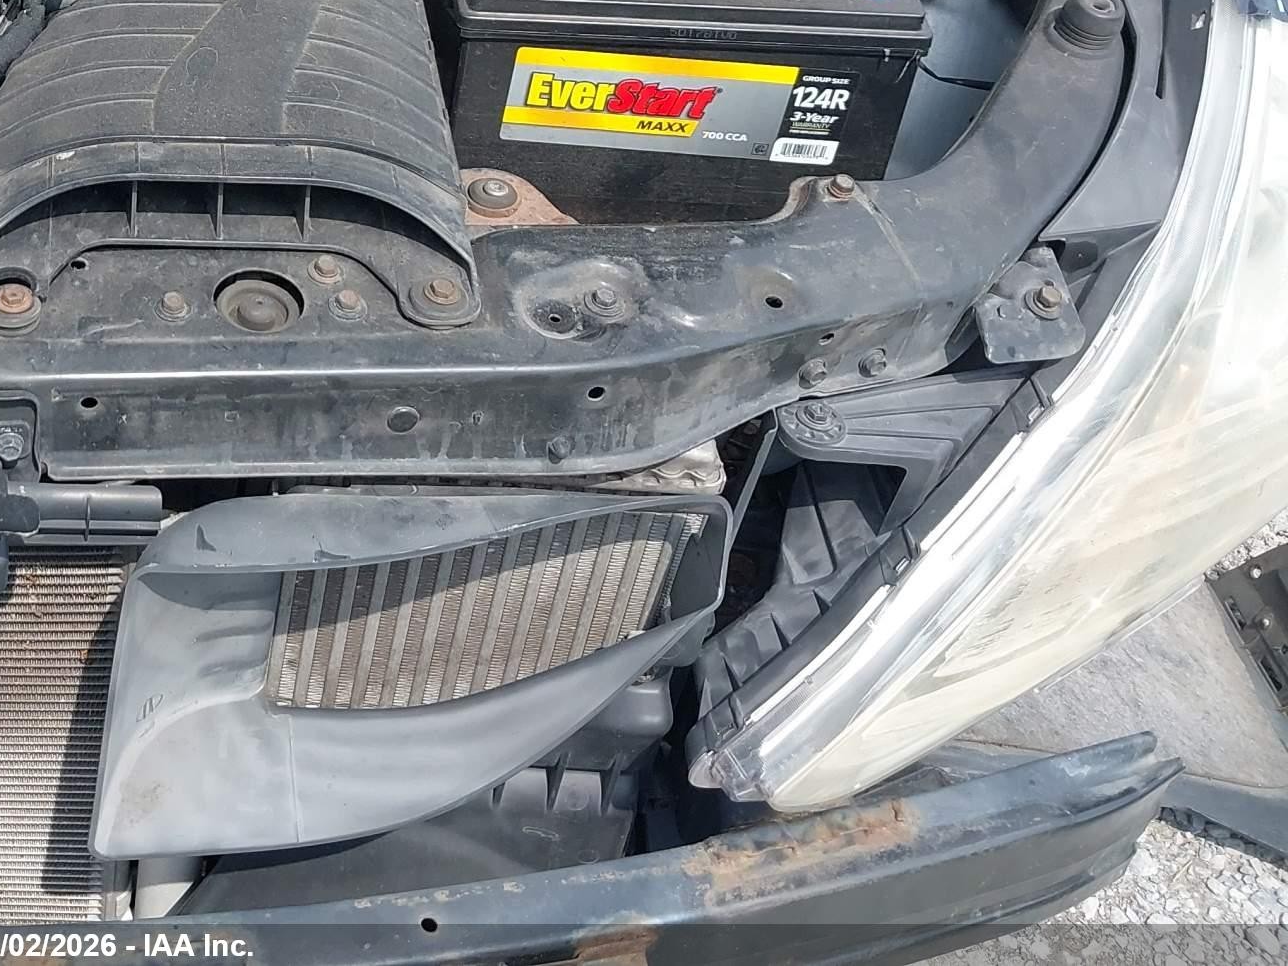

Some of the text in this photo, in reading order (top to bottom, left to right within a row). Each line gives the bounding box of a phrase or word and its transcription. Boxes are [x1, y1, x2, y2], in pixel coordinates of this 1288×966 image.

[803, 75, 851, 85] GROUP SIZE
[525, 71, 718, 120] EverStart
[792, 86, 851, 111] 124R
[789, 111, 840, 124] 3-Year
[636, 120, 690, 133] MAXX
[791, 121, 831, 129] WARRANTY
[702, 131, 749, 142] 700 CCA
